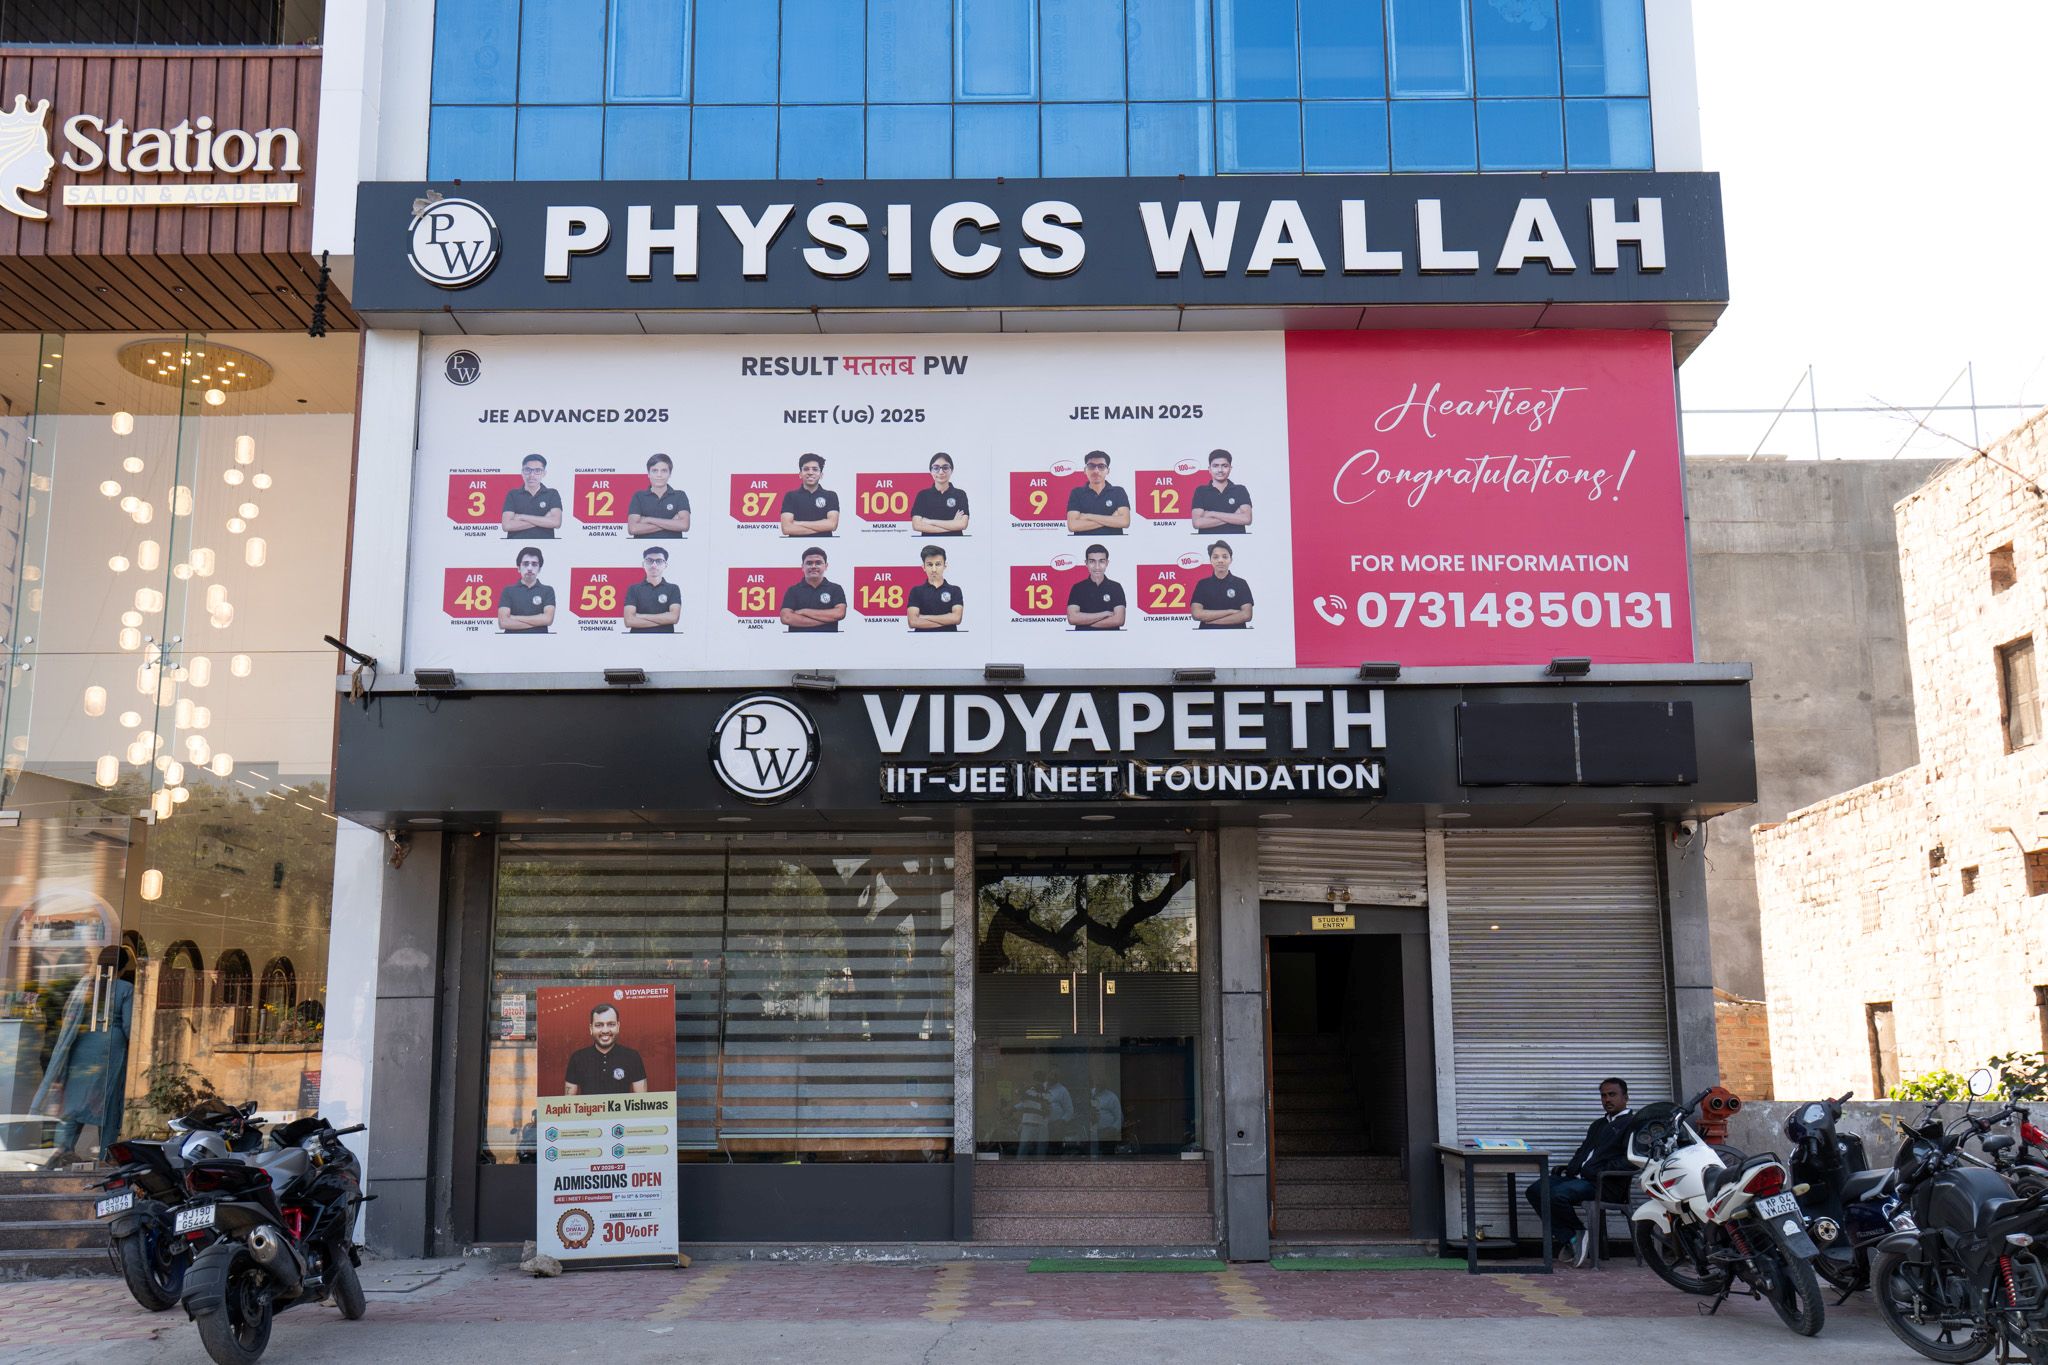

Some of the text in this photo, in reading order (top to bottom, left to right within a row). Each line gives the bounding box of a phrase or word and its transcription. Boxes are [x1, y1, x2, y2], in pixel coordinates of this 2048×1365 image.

[62, 114, 301, 173] Station
[68, 185, 295, 203] SALON & ACADEMY
[544, 197, 1667, 280] PHYSICS WALLAH
[742, 355, 968, 376] RESULT मतलब PW
[478, 408, 669, 423] JEE ADVANCED 2025
[783, 404, 925, 425] NEET (UG) 2025
[1069, 404, 1203, 420] JEE MAIN 2025
[1374, 382, 1588, 438] Heartiest
[469, 481, 487, 489] AIR
[876, 480, 893, 488] AIR
[1030, 479, 1047, 487] AIR
[1333, 449, 1636, 508] Congratulations!
[467, 492, 486, 516] 3
[585, 492, 614, 516] 12
[742, 492, 777, 517] 87
[860, 492, 908, 514] 100
[1029, 490, 1048, 514] 9
[1150, 489, 1180, 513] 12
[1350, 554, 1629, 572] FOR MORE INFORMATION
[466, 575, 483, 583] AIR
[590, 574, 608, 582] AIR
[747, 575, 764, 583] AIR
[874, 573, 892, 581] AIR
[1030, 573, 1047, 581] AIR
[454, 585, 493, 611] 48
[580, 585, 616, 611] 58
[738, 586, 775, 611] 131
[860, 585, 904, 608] 148
[1025, 585, 1053, 609] 13
[1149, 584, 1186, 608] 22
[1356, 591, 1672, 629] 07314850131
[862, 689, 1387, 754] VIDYAPEETH
[887, 767, 1006, 793] IIT-JEE
[1034, 766, 1119, 793] NEET
[1146, 763, 1380, 792] FOUNDATION
[546, 1099, 668, 1117] Aapki Taiyari Ka Vishwas
[554, 1172, 661, 1191] ADMISSIONS OPEN
[1766, 1198, 1776, 1208] MP
